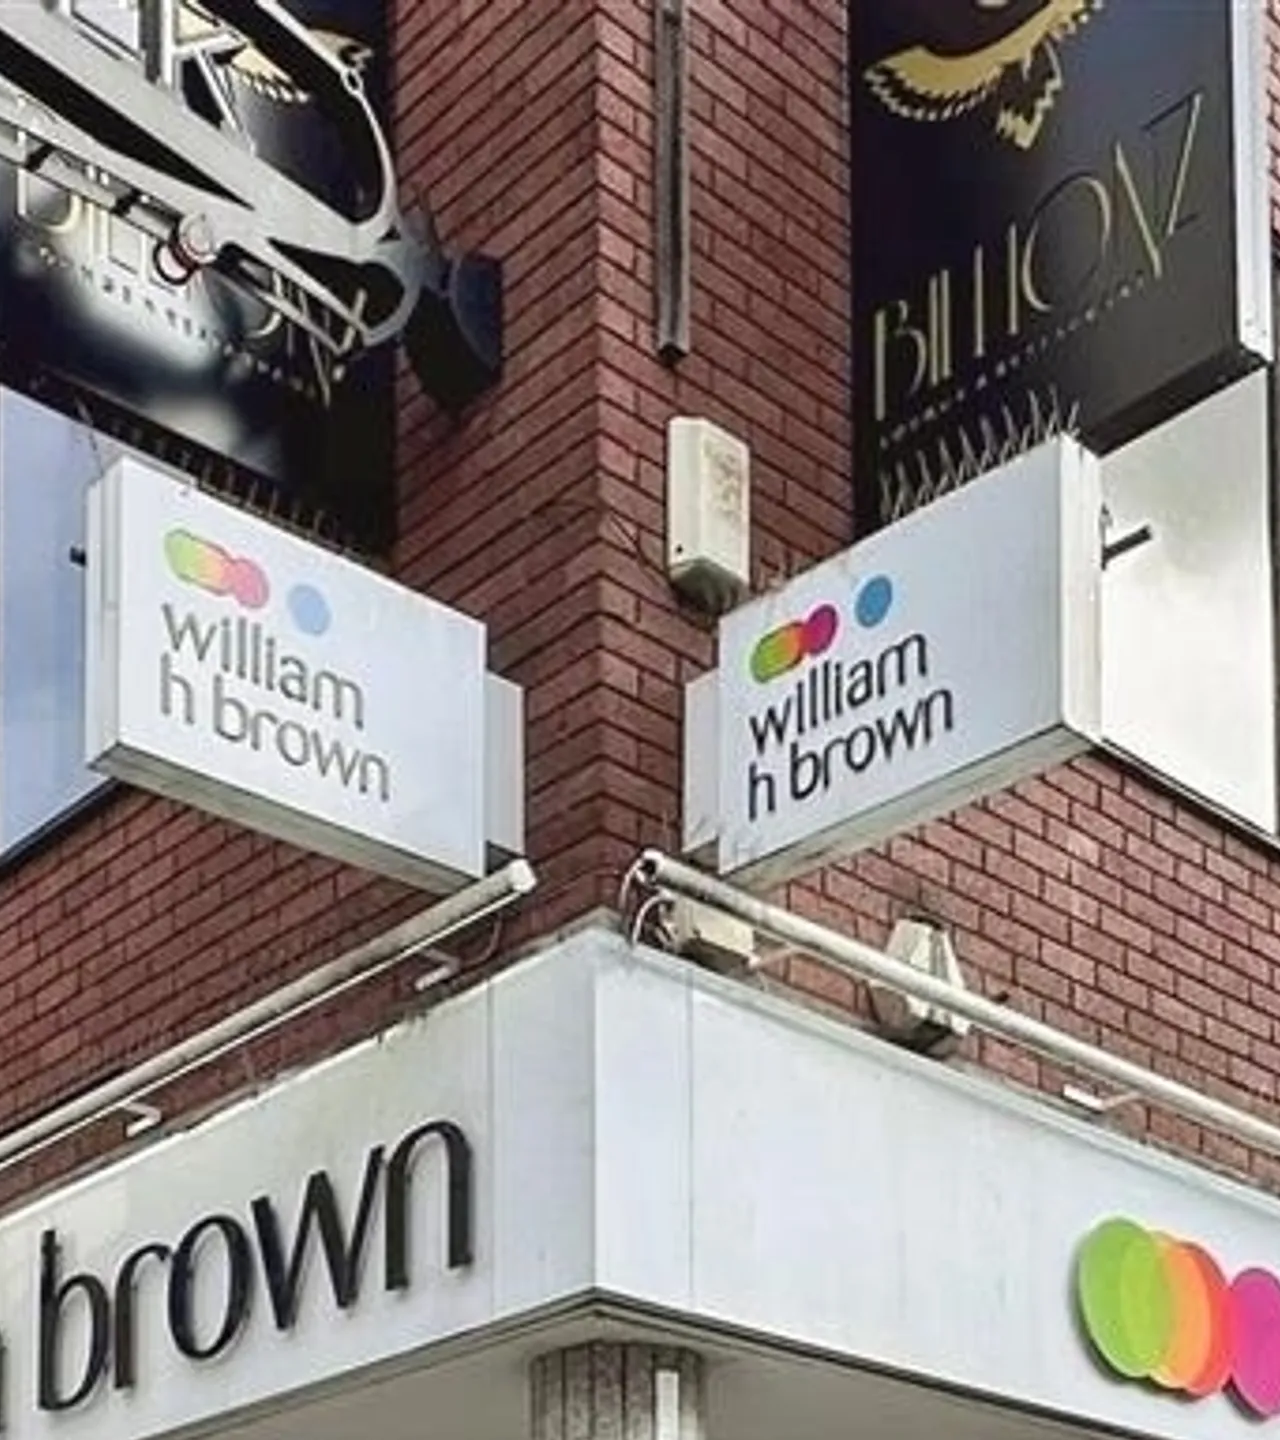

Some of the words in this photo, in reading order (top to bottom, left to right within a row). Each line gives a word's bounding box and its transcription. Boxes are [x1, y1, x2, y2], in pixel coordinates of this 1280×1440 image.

[160, 652, 195, 726] h
[213, 674, 390, 803] brown
[162, 602, 364, 731] william
[749, 633, 928, 757] william
[748, 761, 776, 822] h
[789, 688, 953, 801] brown
[36, 1117, 476, 1413] brown
